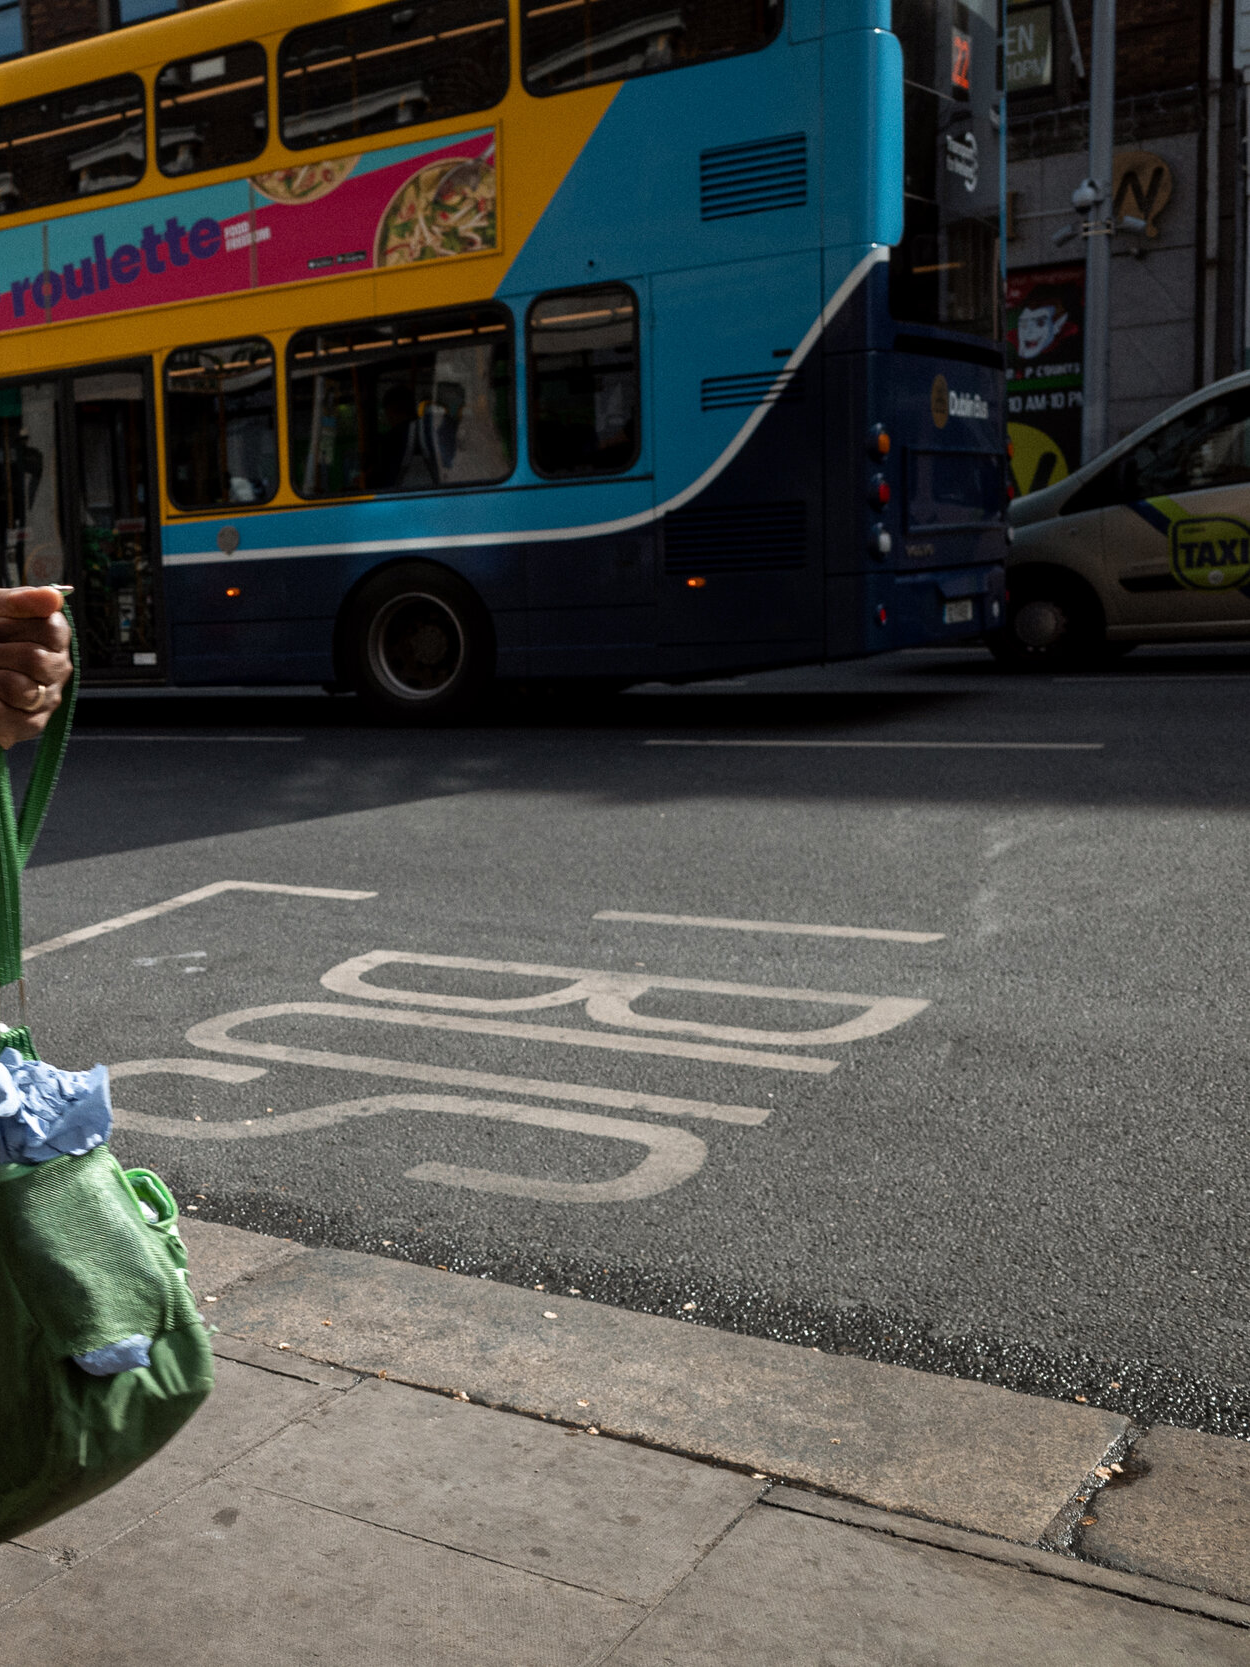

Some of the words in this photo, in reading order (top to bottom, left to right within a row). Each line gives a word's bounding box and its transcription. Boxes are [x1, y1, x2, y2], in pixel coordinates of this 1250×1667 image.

[11, 217, 222, 318] roulette
[1180, 538, 1249, 568] TAXI
[108, 950, 933, 1201] BUS
